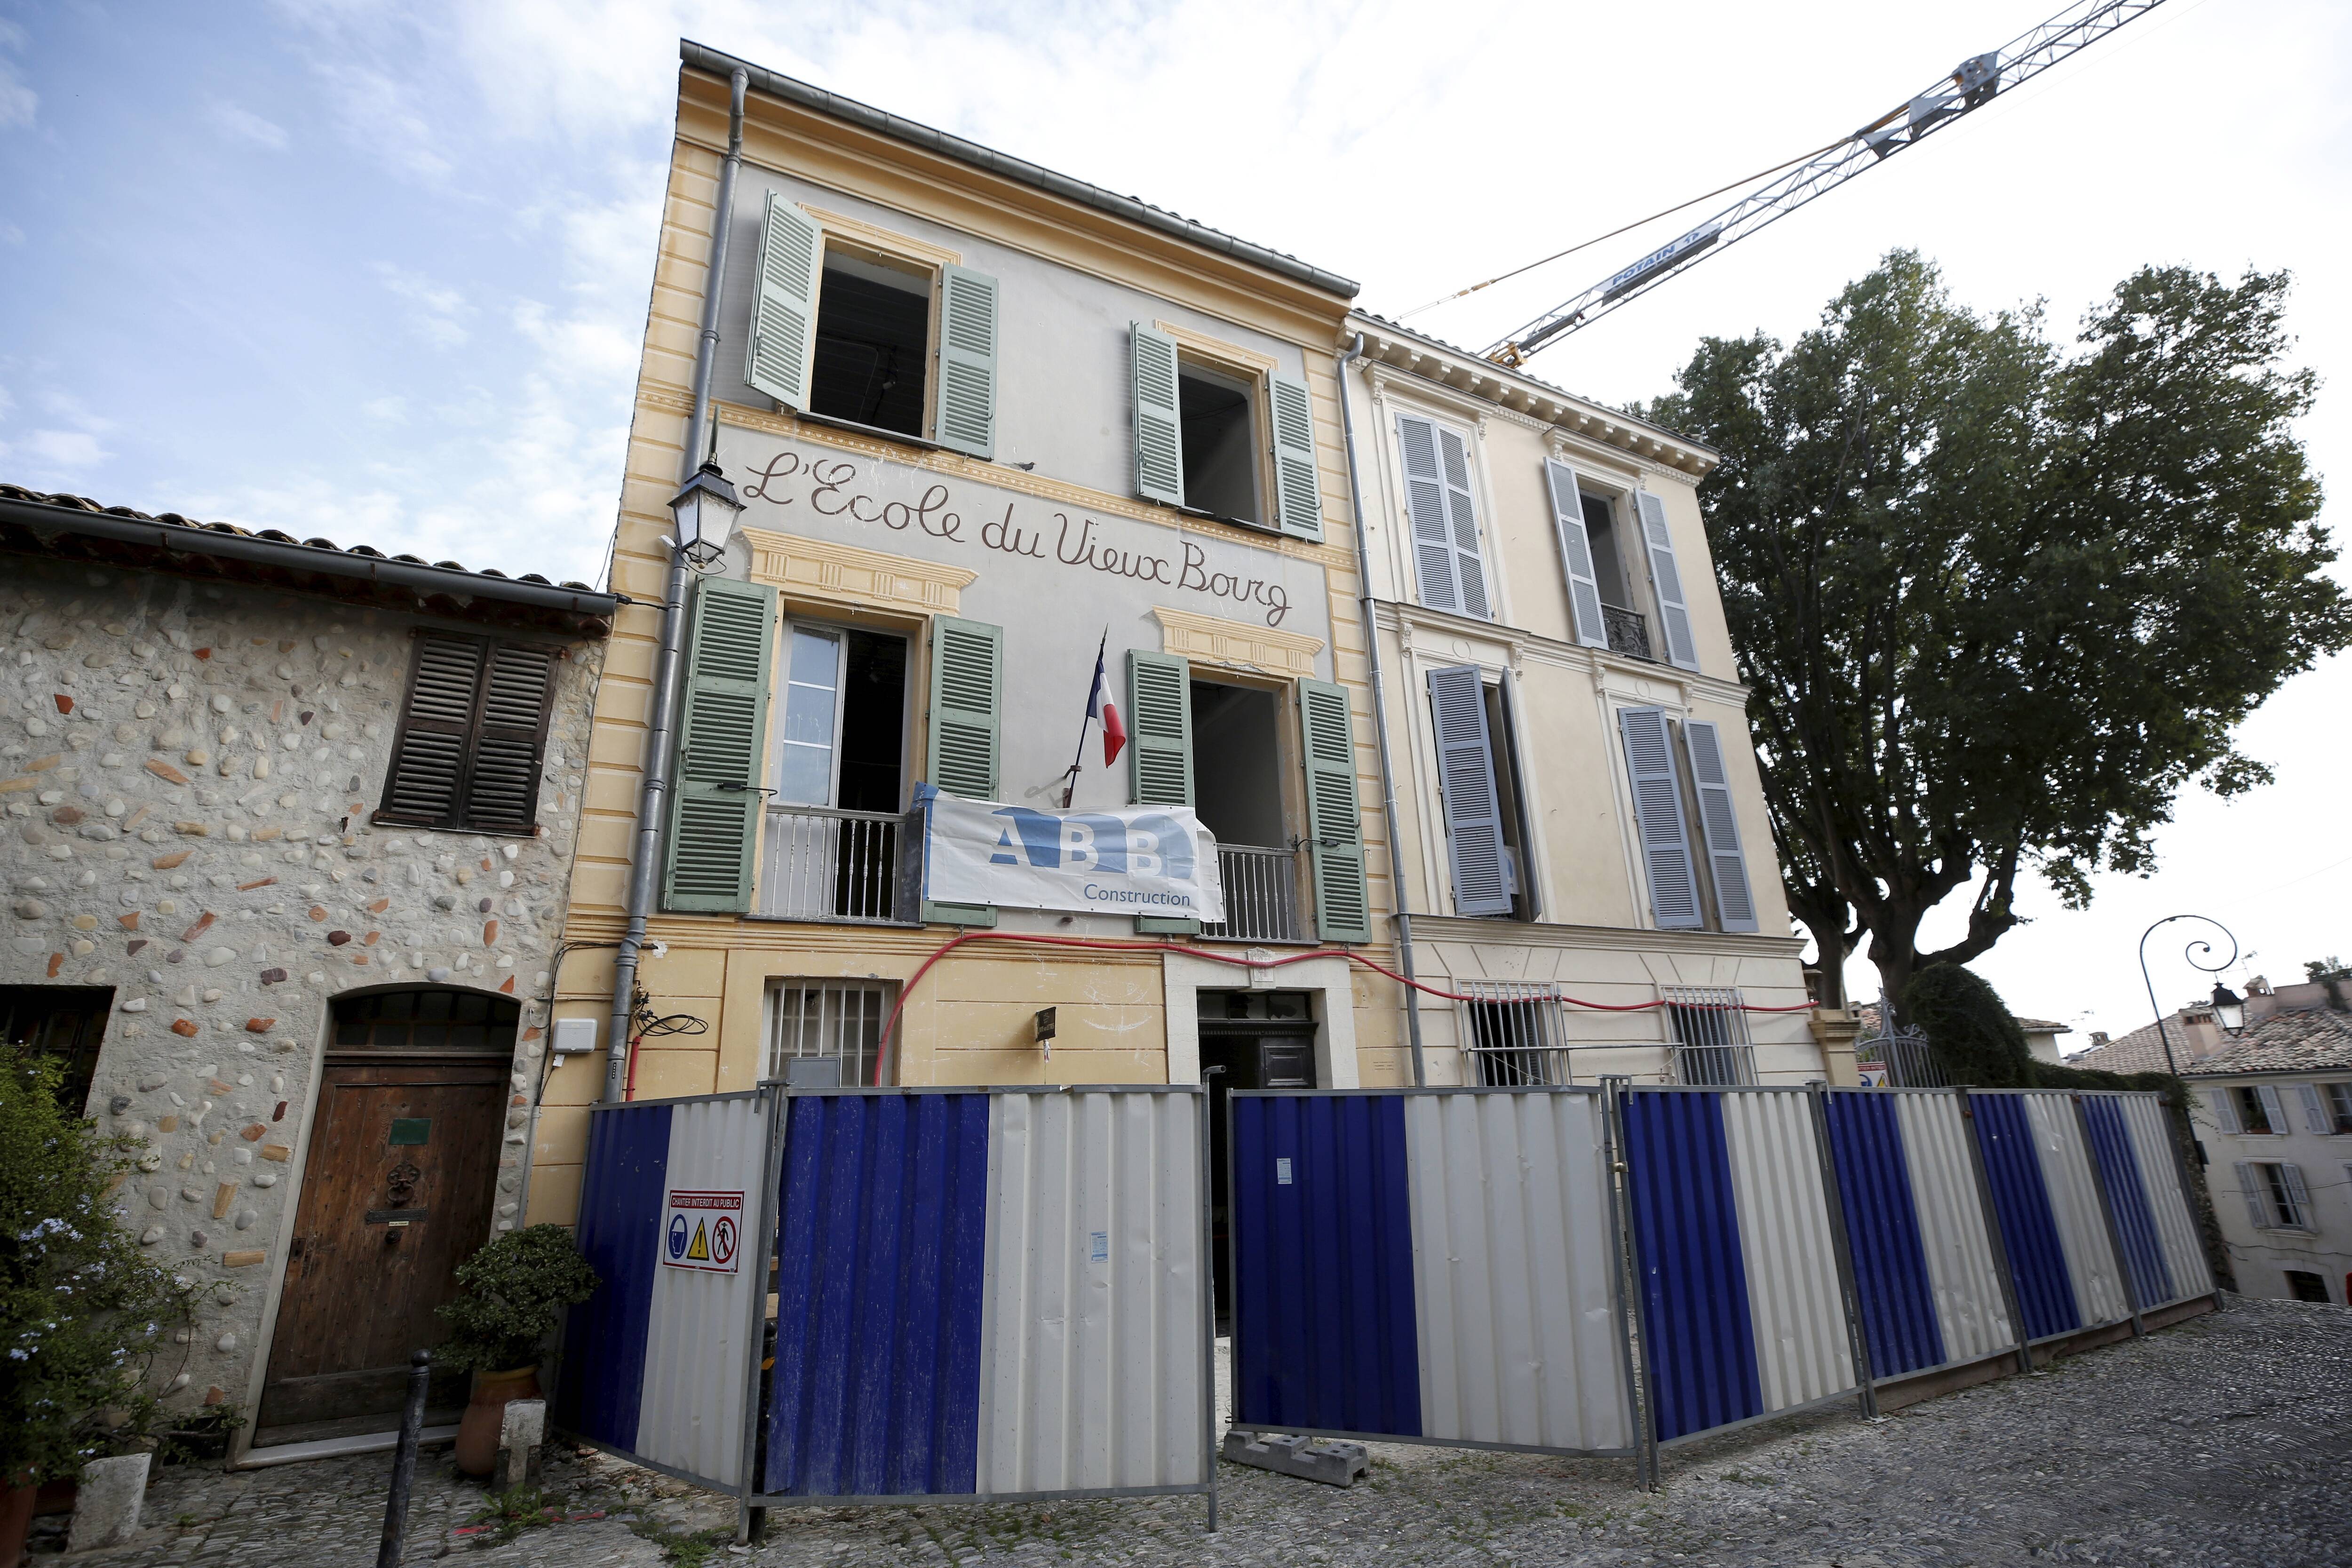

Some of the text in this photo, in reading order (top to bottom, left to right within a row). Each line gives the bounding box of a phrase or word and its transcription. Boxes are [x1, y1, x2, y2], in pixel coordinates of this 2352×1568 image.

[1613, 245, 1675, 285] POTAIN
[981, 502, 1046, 559] du
[1054, 513, 1172, 586] Vieux
[1177, 539, 1293, 627] Bourg
[989, 807, 1194, 880] ABB
[1083, 883, 1191, 907] Construction
[672, 1197, 691, 1206] CHANTIER
[691, 1198, 713, 1207] INTERDIT
[720, 1199, 739, 1208] PUBLIC
